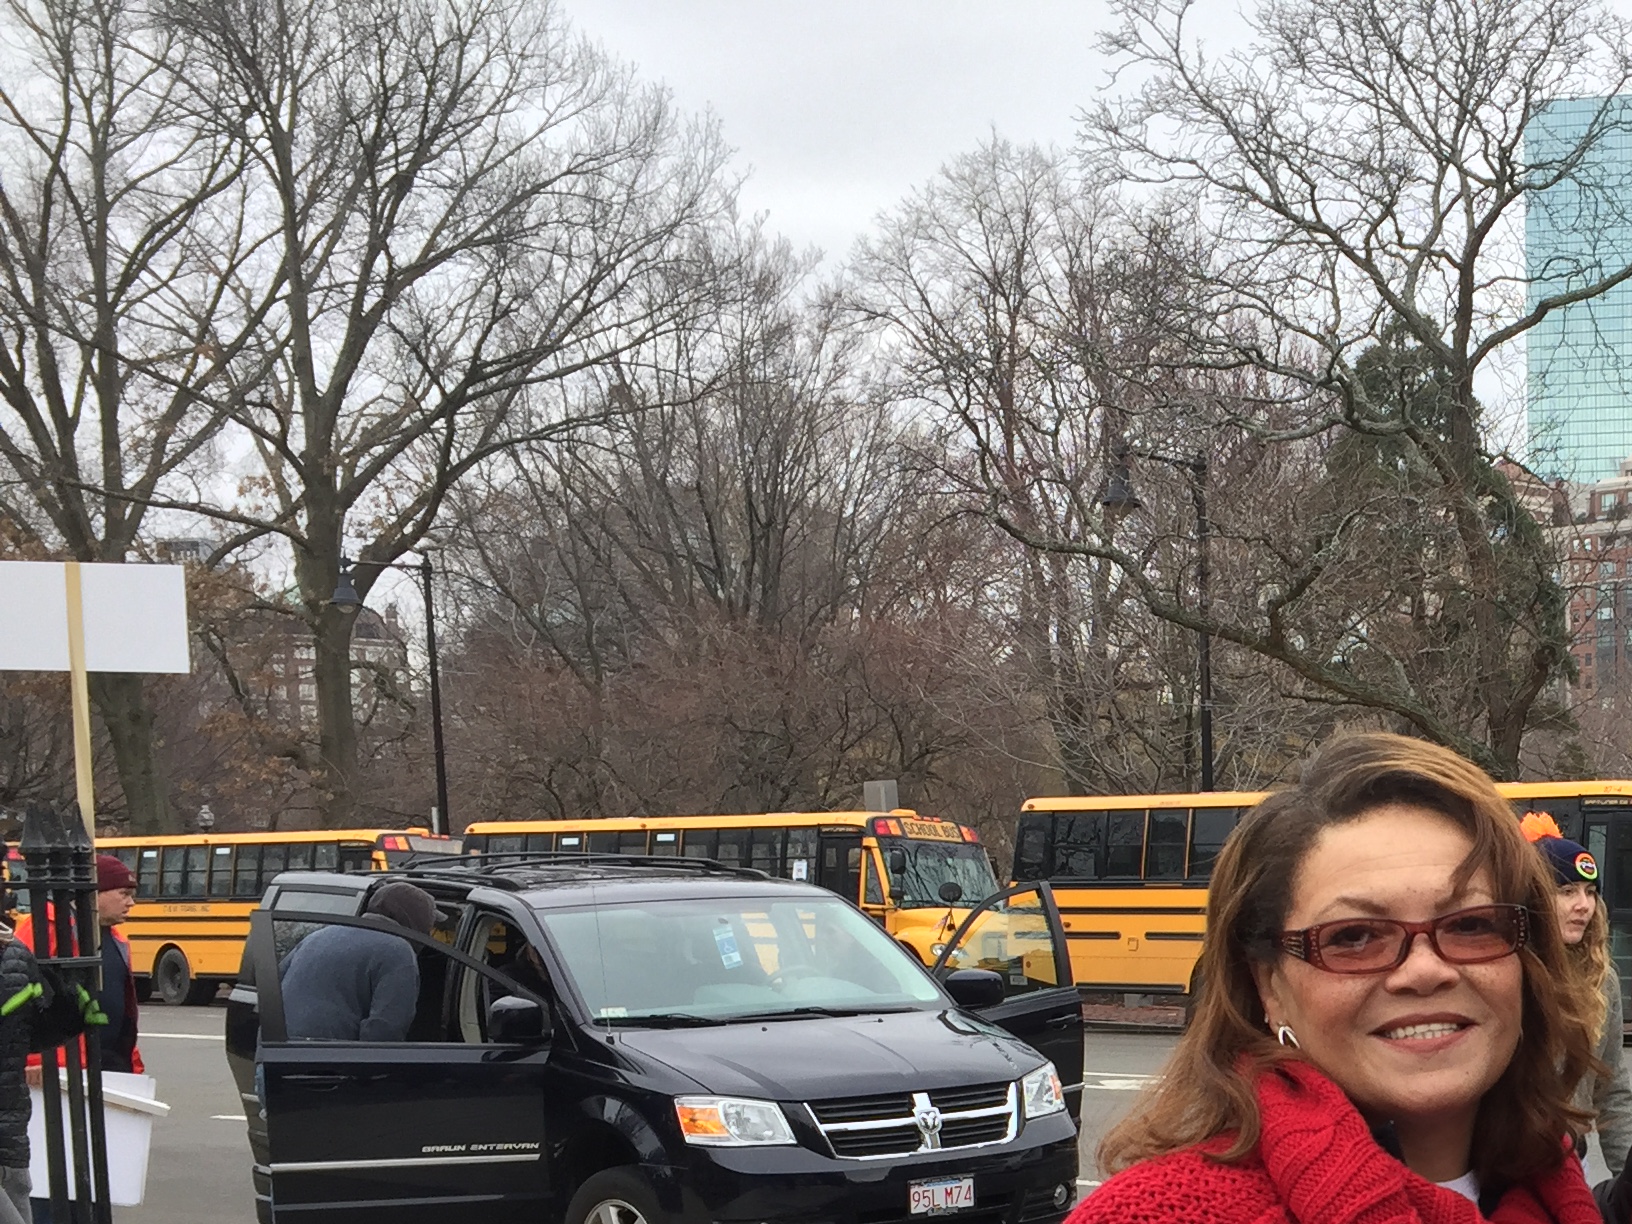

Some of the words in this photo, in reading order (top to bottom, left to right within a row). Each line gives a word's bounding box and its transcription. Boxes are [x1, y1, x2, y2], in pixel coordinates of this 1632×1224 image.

[904, 821, 943, 838] SCHOOL
[943, 826, 960, 839] BUS
[421, 1143, 467, 1153] BRAUN
[469, 1142, 540, 1151] ENTERVAN
[912, 1188, 941, 1210] 95L
[944, 1184, 973, 1206] M74
